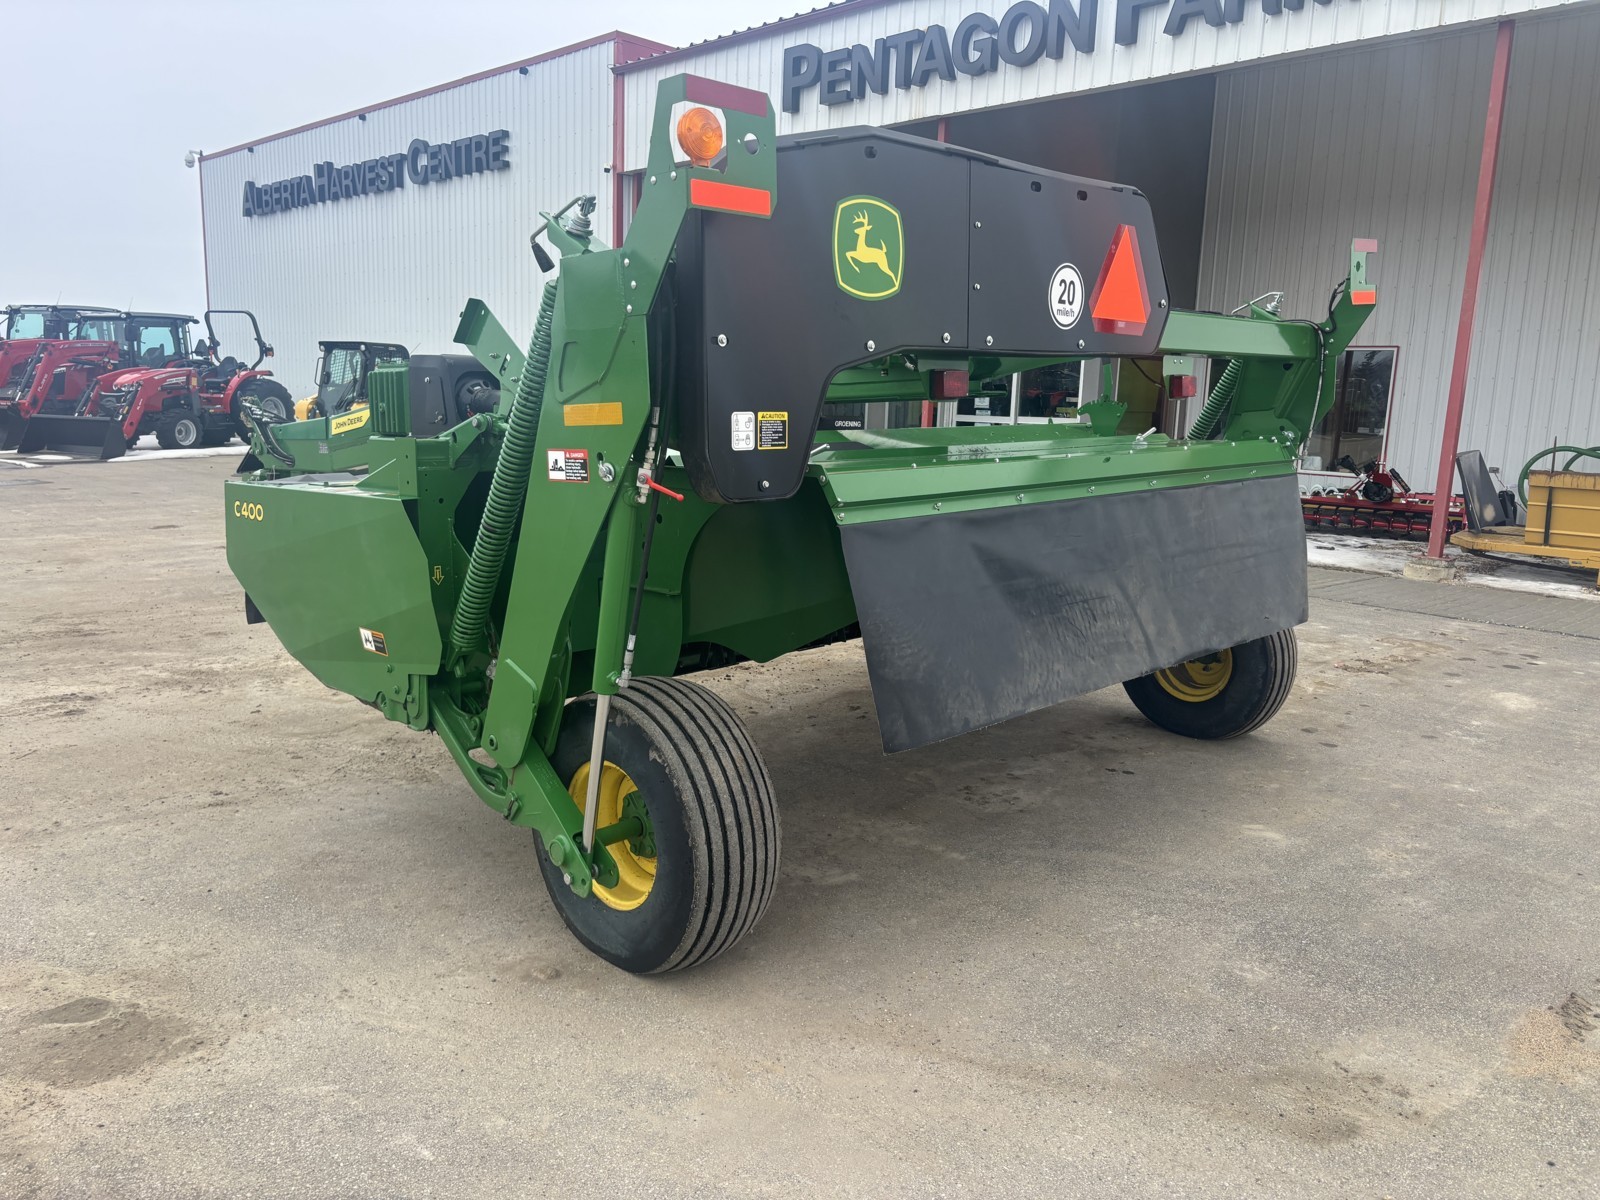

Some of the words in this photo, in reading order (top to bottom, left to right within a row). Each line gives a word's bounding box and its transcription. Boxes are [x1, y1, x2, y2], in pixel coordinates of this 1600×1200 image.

[783, 0, 1095, 113] PENTAGON
[242, 175, 315, 217] ALBERTA
[313, 152, 407, 203] HARVEST
[407, 129, 510, 185] CENTRE
[1058, 279, 1075, 306] 20
[334, 421, 347, 430] JOHN
[347, 416, 363, 426] DEERE
[234, 500, 264, 521] C400
